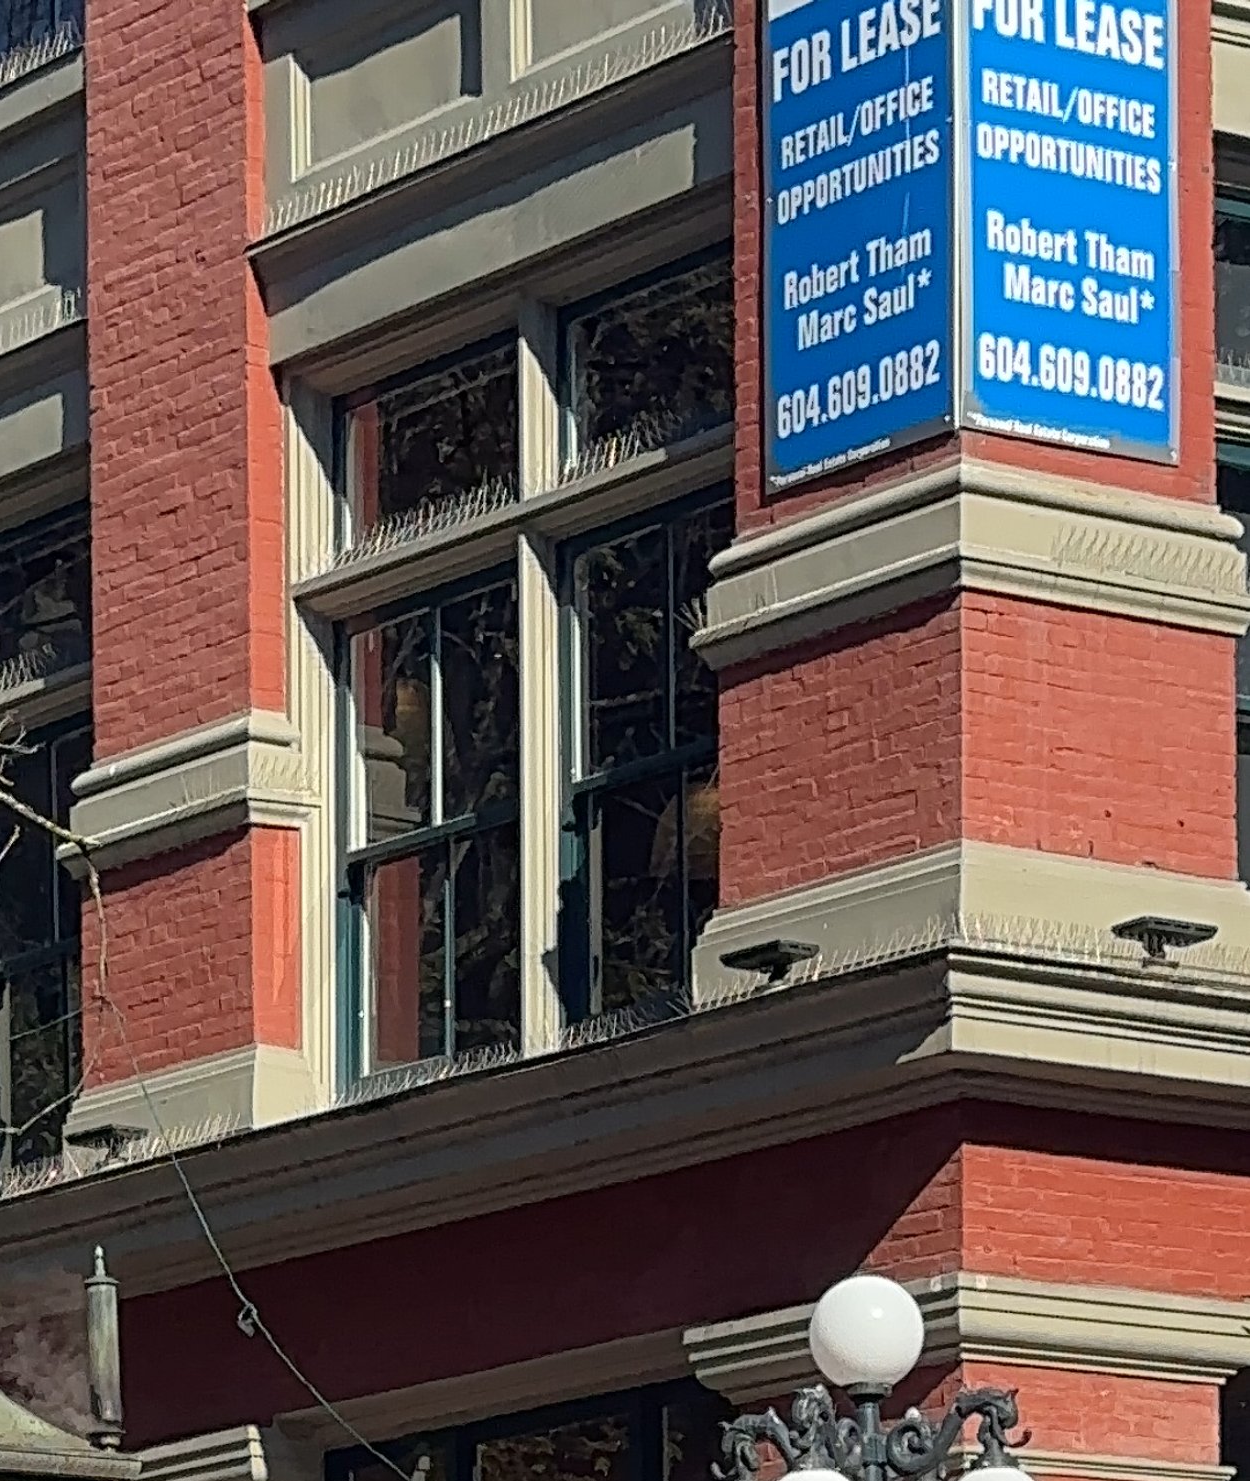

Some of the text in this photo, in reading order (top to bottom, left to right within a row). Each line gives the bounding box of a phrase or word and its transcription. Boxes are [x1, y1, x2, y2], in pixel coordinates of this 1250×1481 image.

[773, 0, 941, 102] FOR LEASE
[1055, 0, 1164, 70] LEASE
[781, 75, 934, 170] RETAIL/OFFICE
[982, 67, 1155, 139] RETAIL/OFFICE
[777, 128, 940, 226] OPPORTUNITIES
[977, 122, 1161, 195] OPPORTUNITIES
[784, 228, 932, 310] Robert Tham
[986, 208, 1154, 281] Robert Tham
[1003, 262, 1075, 311] Marc
[798, 304, 857, 351] Marc
[777, 339, 940, 439] 604.609.0882
[978, 332, 1164, 411] 604.609.0882
